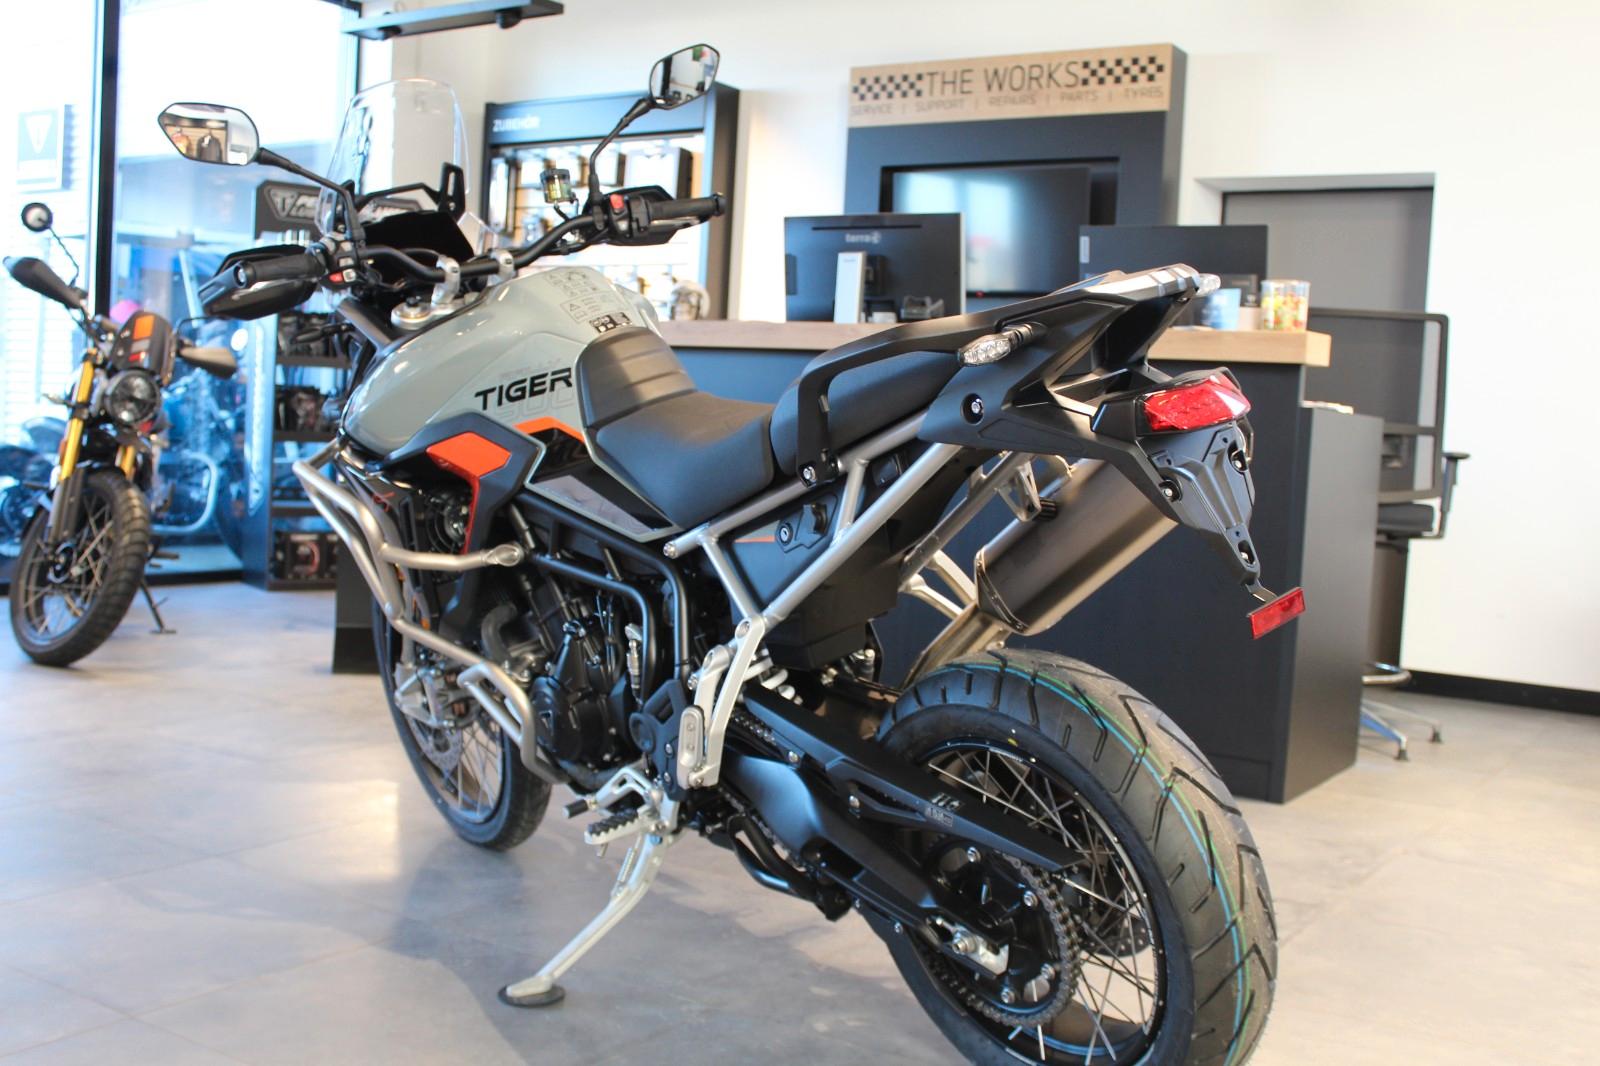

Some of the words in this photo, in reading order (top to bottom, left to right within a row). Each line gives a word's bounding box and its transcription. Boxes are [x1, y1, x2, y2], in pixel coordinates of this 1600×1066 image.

[927, 69, 974, 96] THE
[984, 61, 1080, 92] WORKS
[850, 104, 893, 116] SERVICE
[915, 98, 965, 113] SUPPORT
[988, 94, 1036, 106] REPAIRS
[1060, 89, 1099, 103] PARTS
[1124, 87, 1163, 99] TYRES
[474, 367, 573, 411] TIGER
